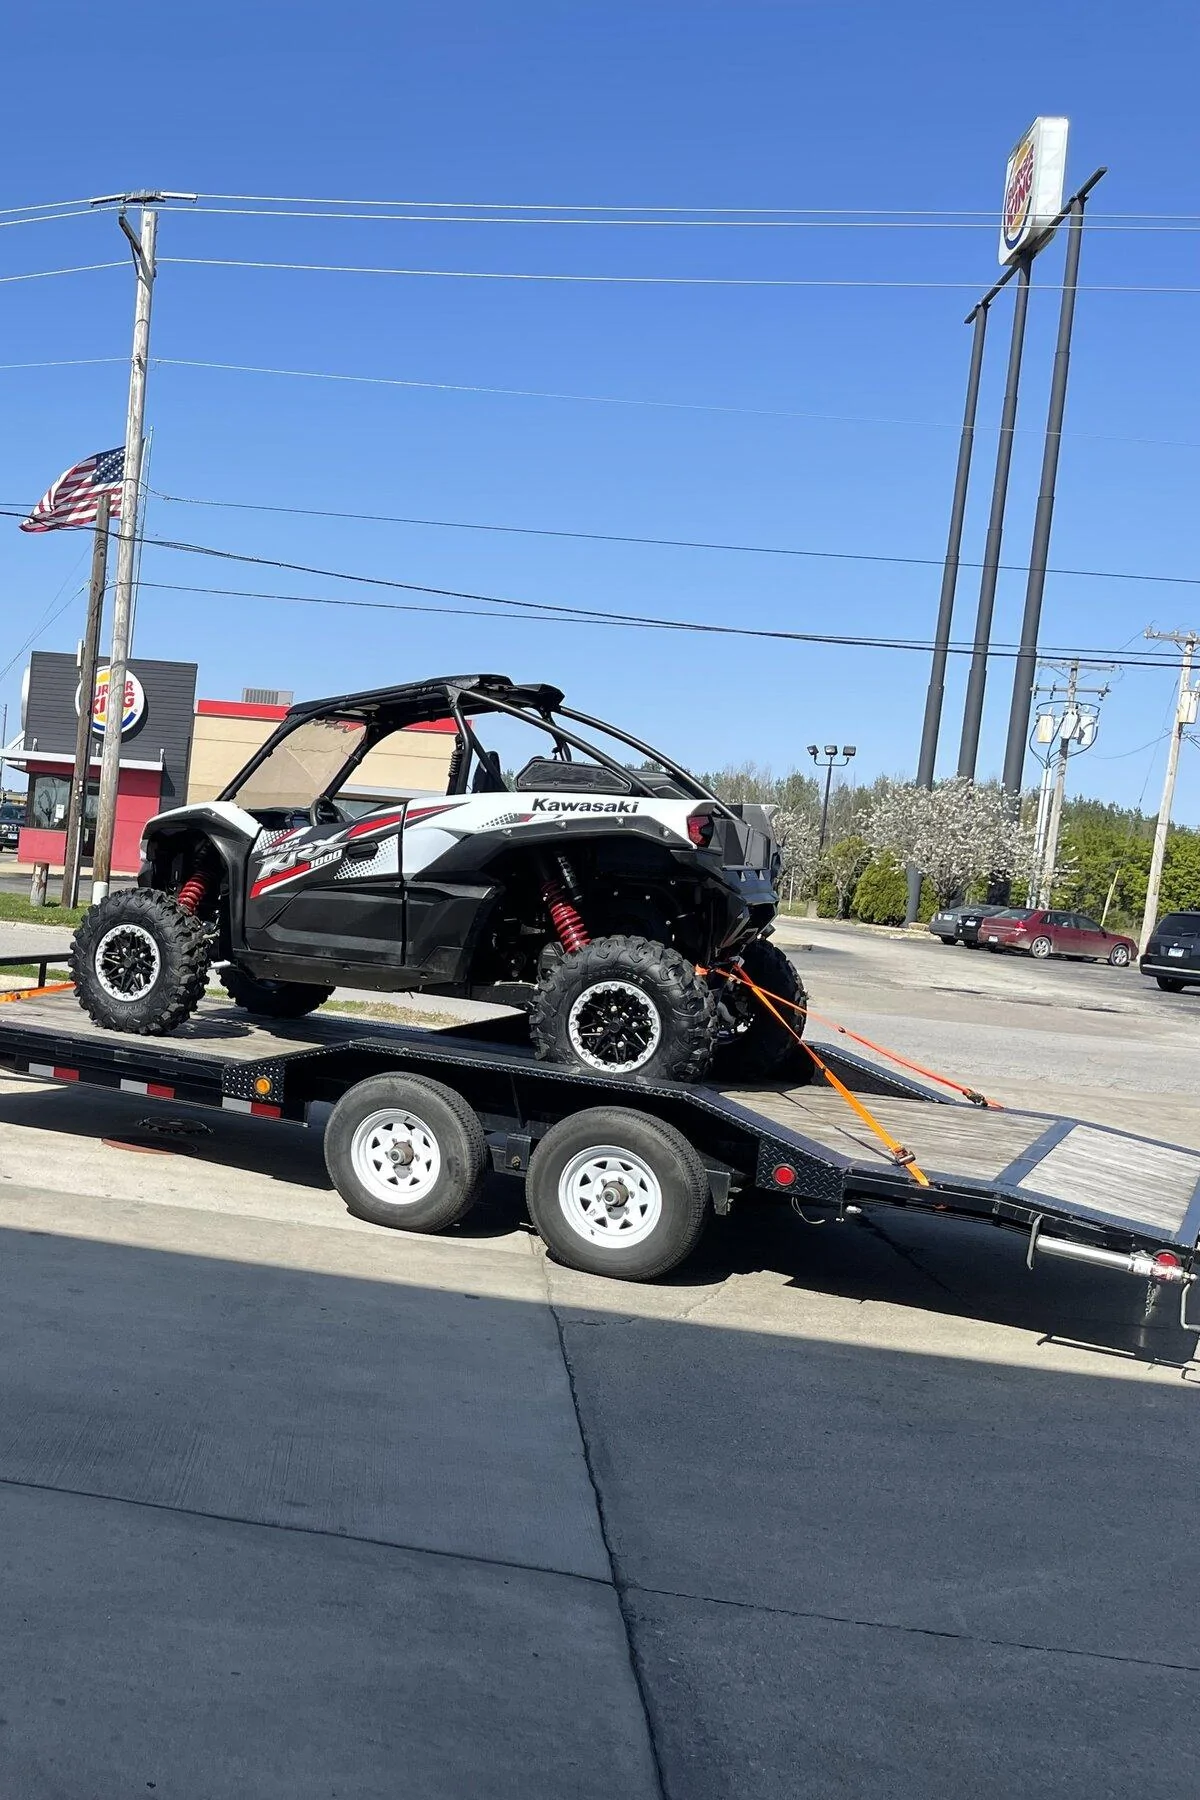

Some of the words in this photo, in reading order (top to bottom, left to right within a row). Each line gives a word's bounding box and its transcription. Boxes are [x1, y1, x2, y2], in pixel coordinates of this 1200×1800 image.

[93, 692, 135, 714] KIG
[532, 798, 639, 813] Kawasaki
[310, 850, 343, 869] 1000
